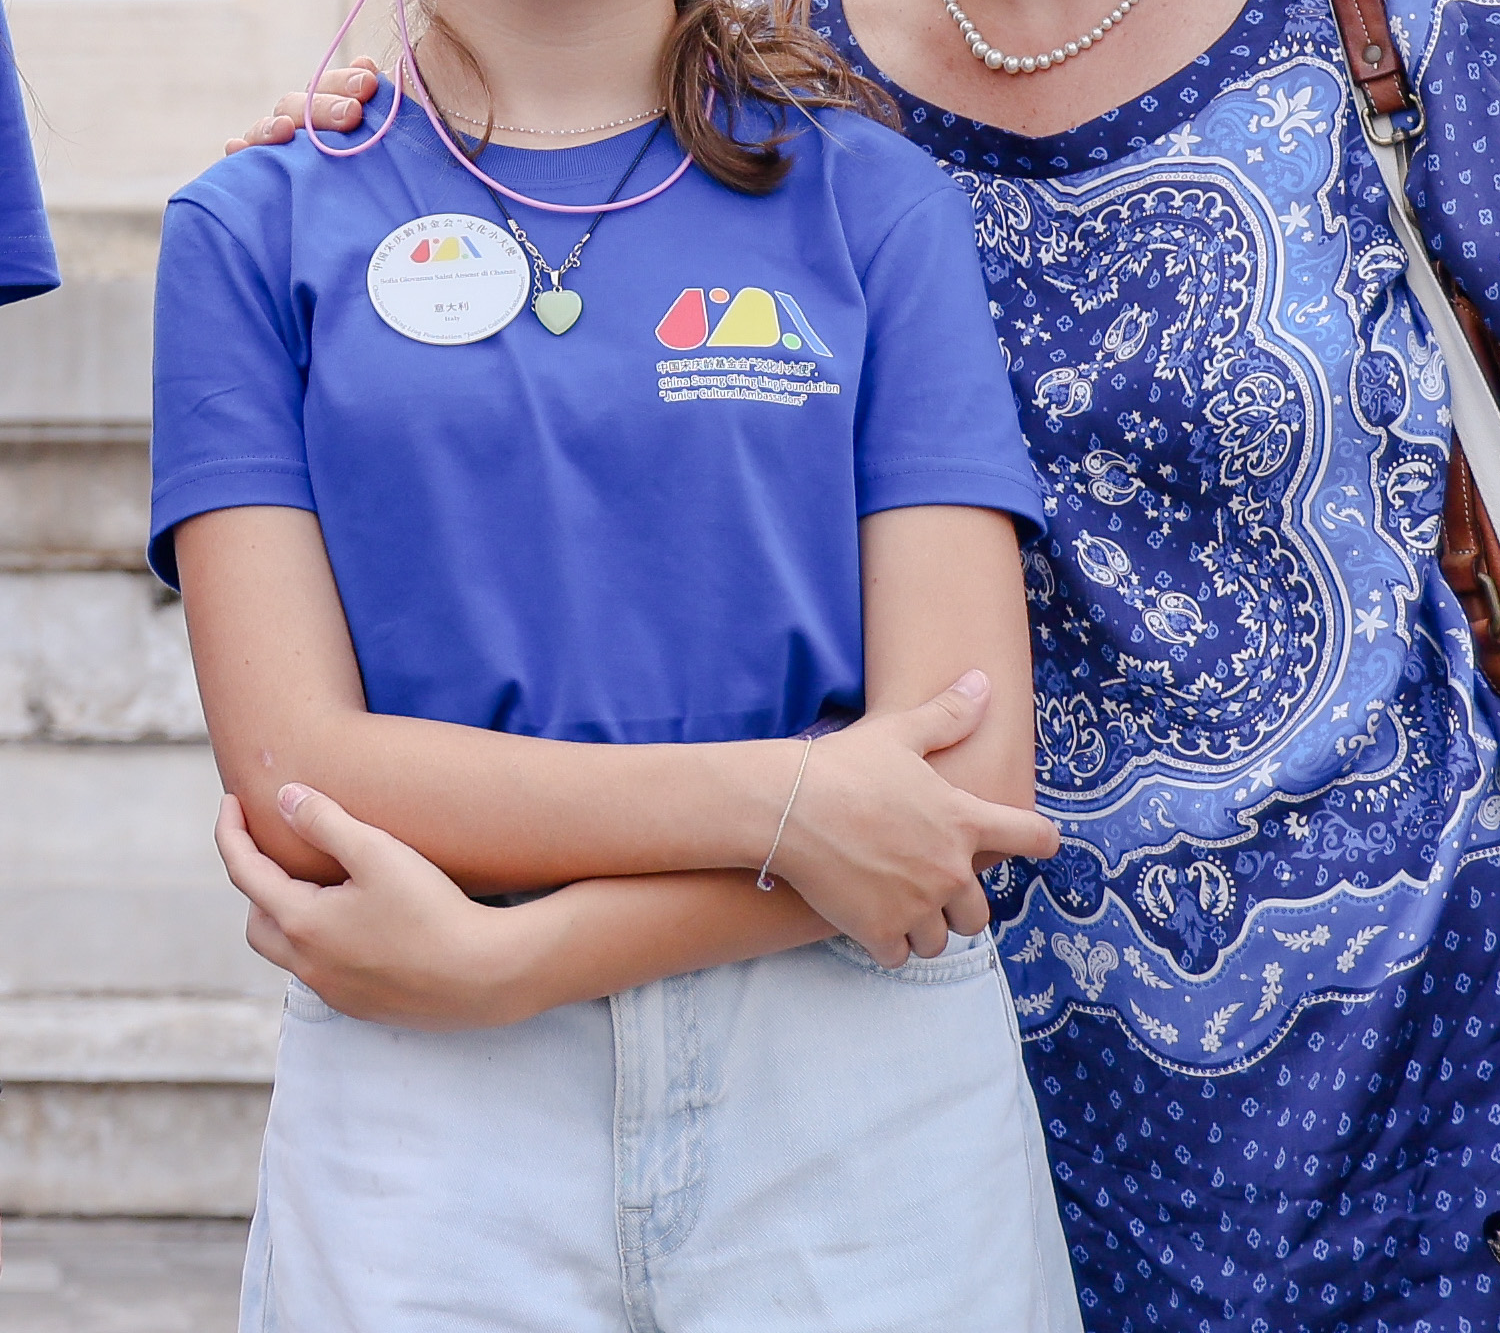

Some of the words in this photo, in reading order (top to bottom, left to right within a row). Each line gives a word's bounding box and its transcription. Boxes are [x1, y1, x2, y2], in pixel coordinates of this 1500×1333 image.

[433, 301, 470, 313] 意大利
[444, 315, 460, 323] Italy
[658, 376, 690, 389] China
[691, 374, 726, 388] Soong
[727, 373, 757, 389] Ching
[758, 375, 780, 392] Ling
[780, 378, 841, 394] Foundation
[698, 387, 740, 400] Cultural
